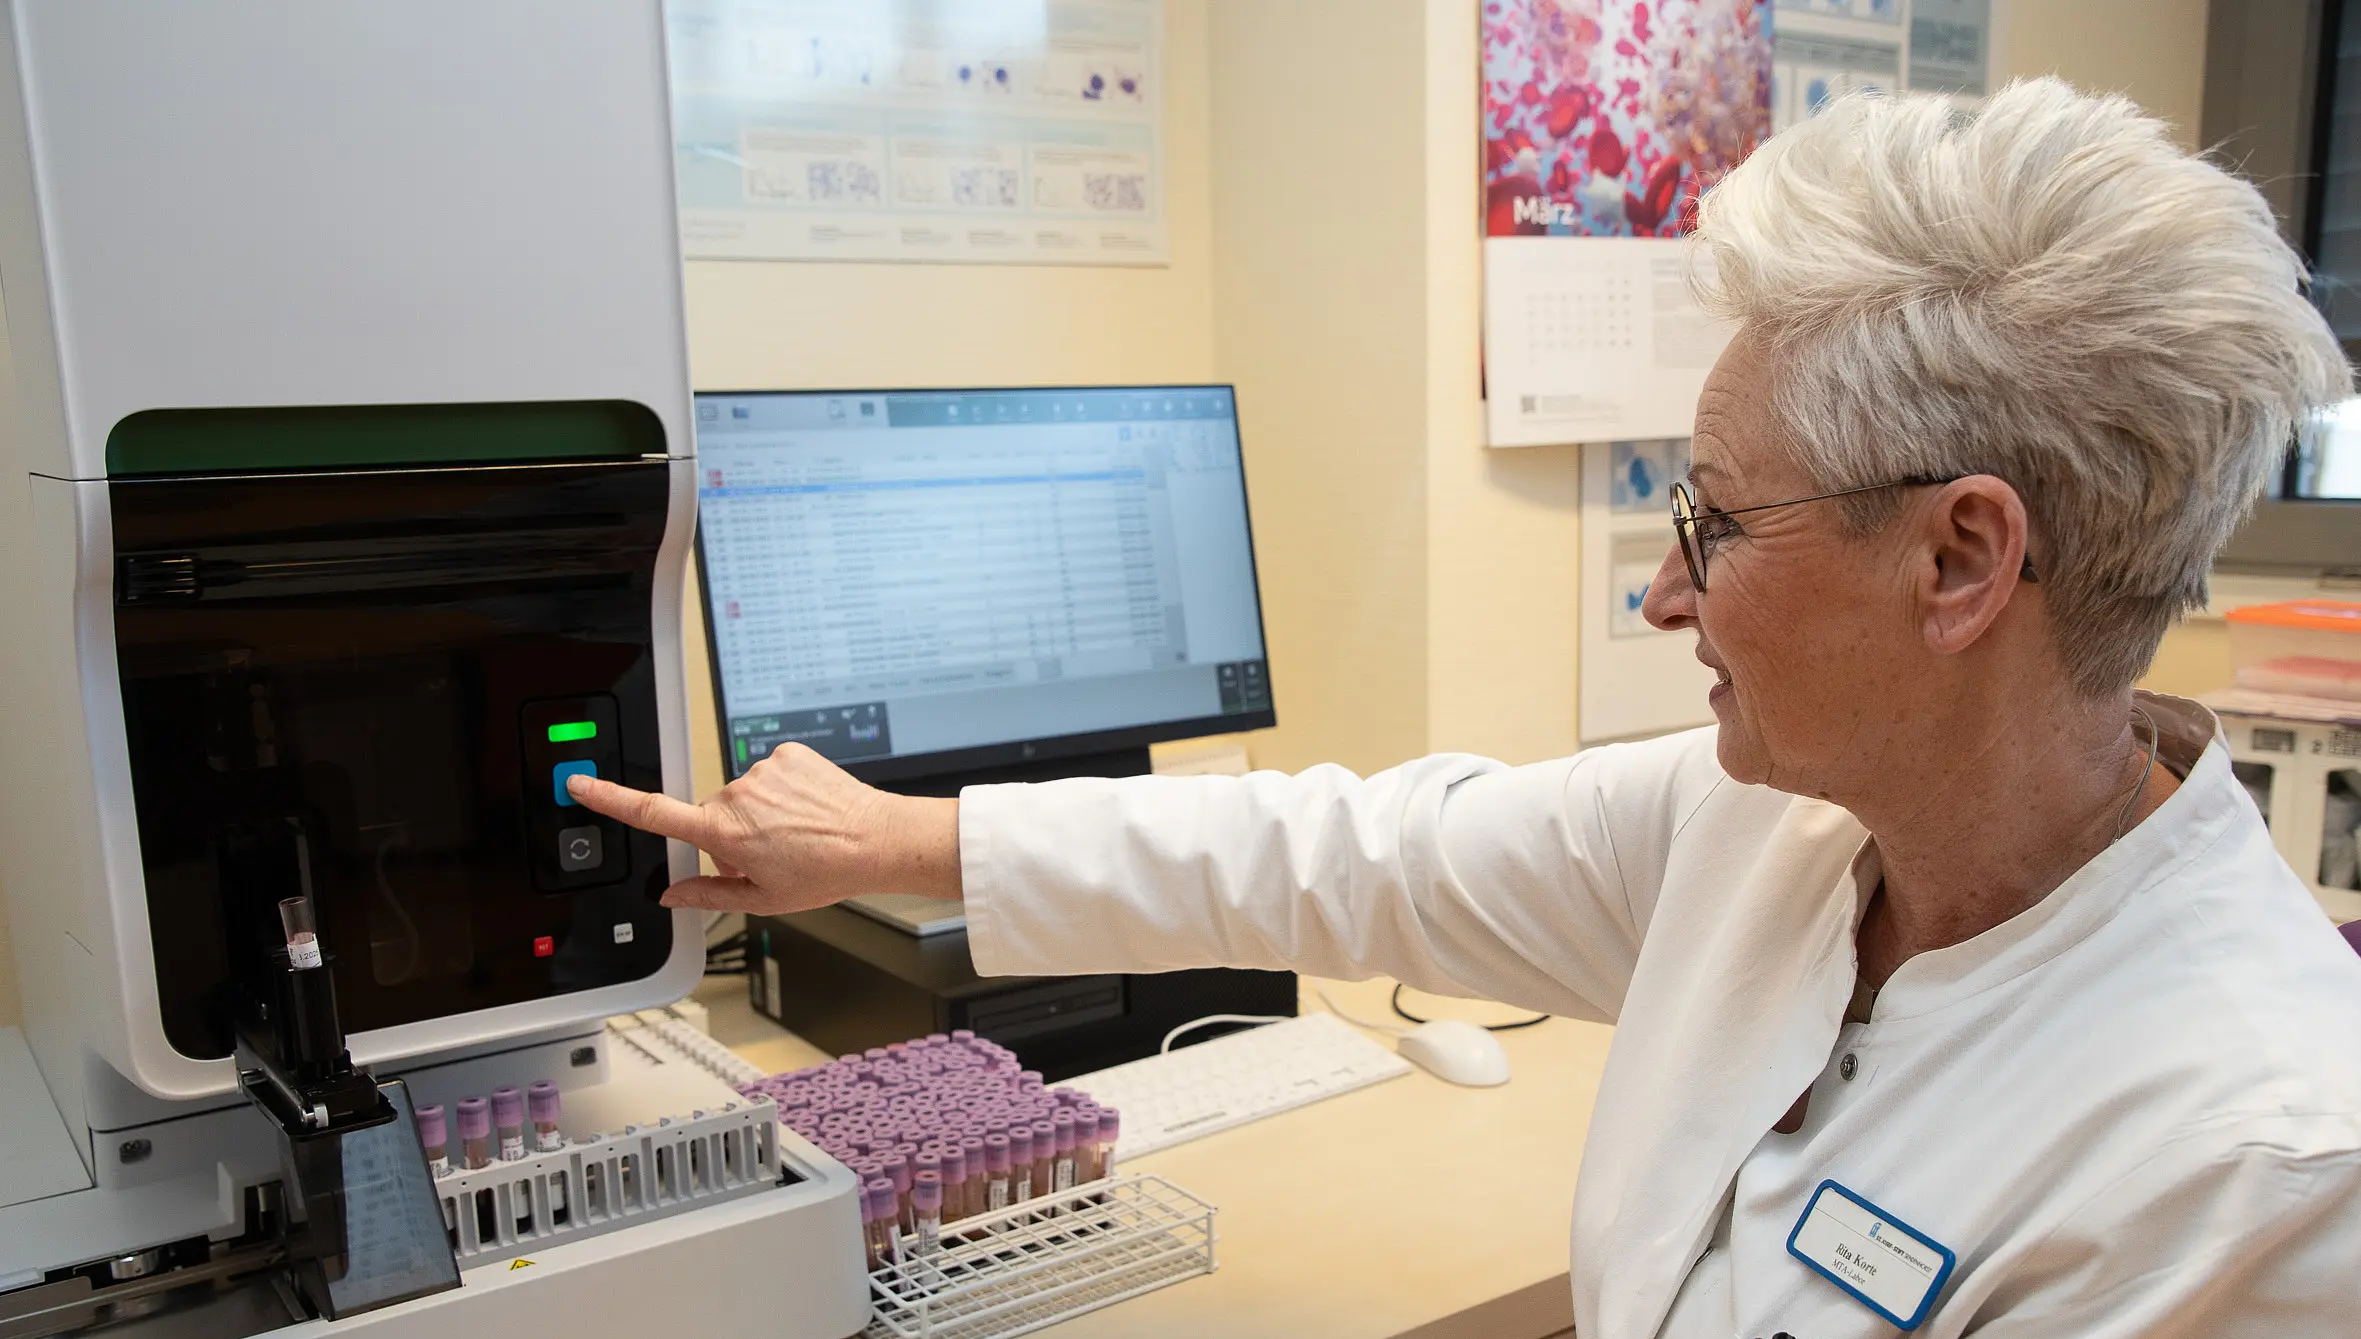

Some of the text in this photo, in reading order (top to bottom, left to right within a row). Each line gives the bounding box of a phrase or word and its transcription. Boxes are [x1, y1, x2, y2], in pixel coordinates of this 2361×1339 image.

[1513, 195, 1574, 225] März
[1832, 1258, 1866, 1284] MTA-Labor
[1835, 1243, 1877, 1276] Rita Korte
